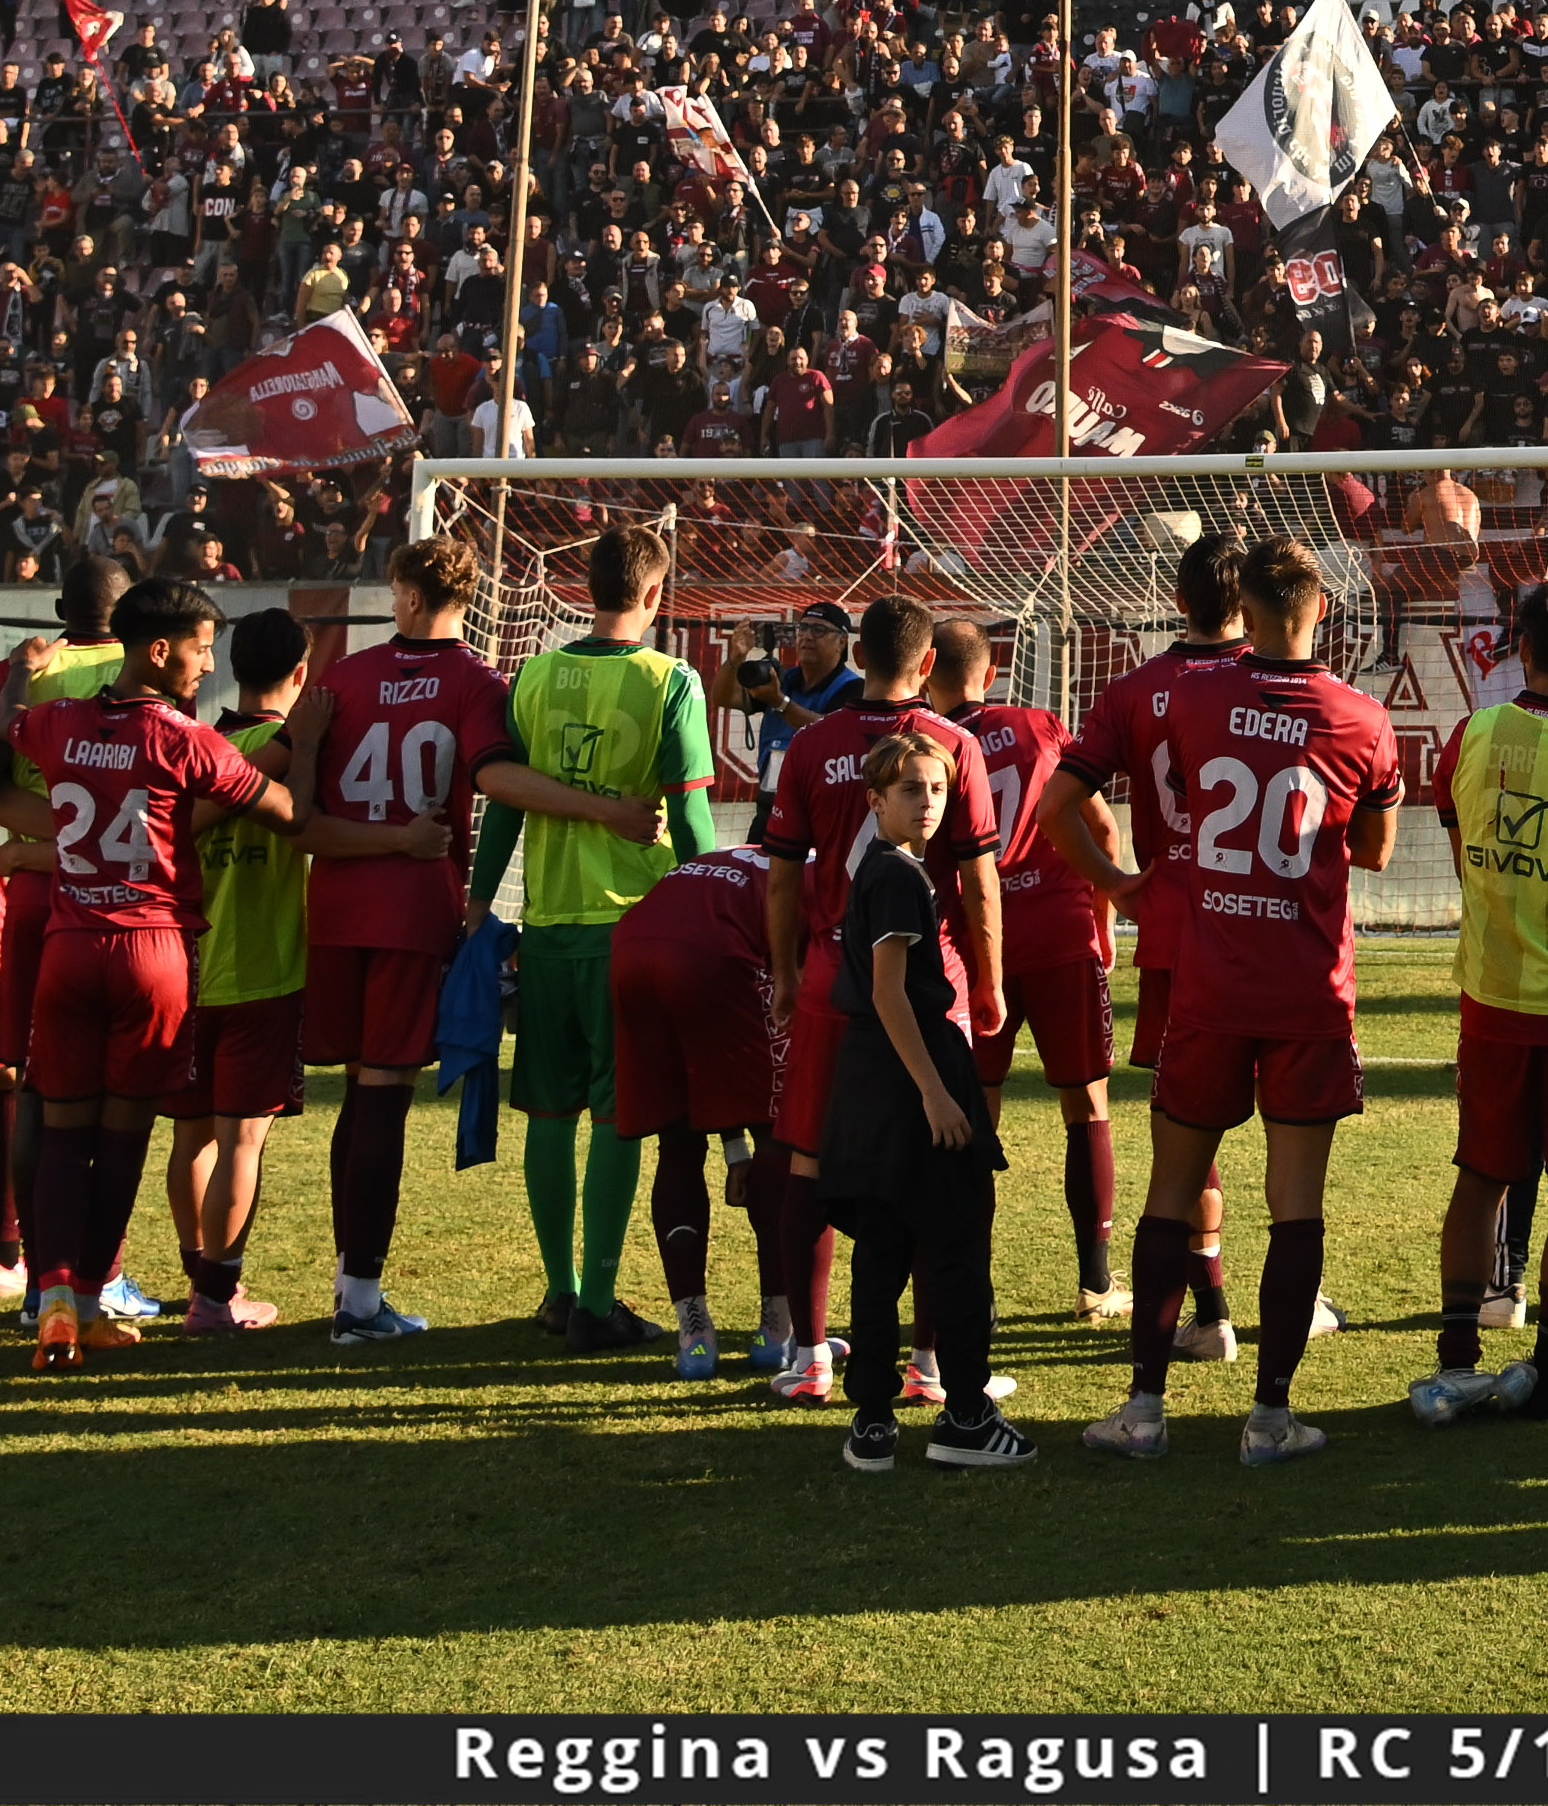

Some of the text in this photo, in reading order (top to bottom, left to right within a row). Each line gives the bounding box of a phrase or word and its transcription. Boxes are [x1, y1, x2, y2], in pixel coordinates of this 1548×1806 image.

[380, 677, 440, 705] RIZZO
[1230, 707, 1309, 746] EDERA
[64, 737, 137, 771] LAARIBI
[339, 720, 458, 822] 40
[51, 781, 158, 883] 24
[1198, 756, 1329, 879] 20
[1202, 889, 1292, 920] SOSETEG
